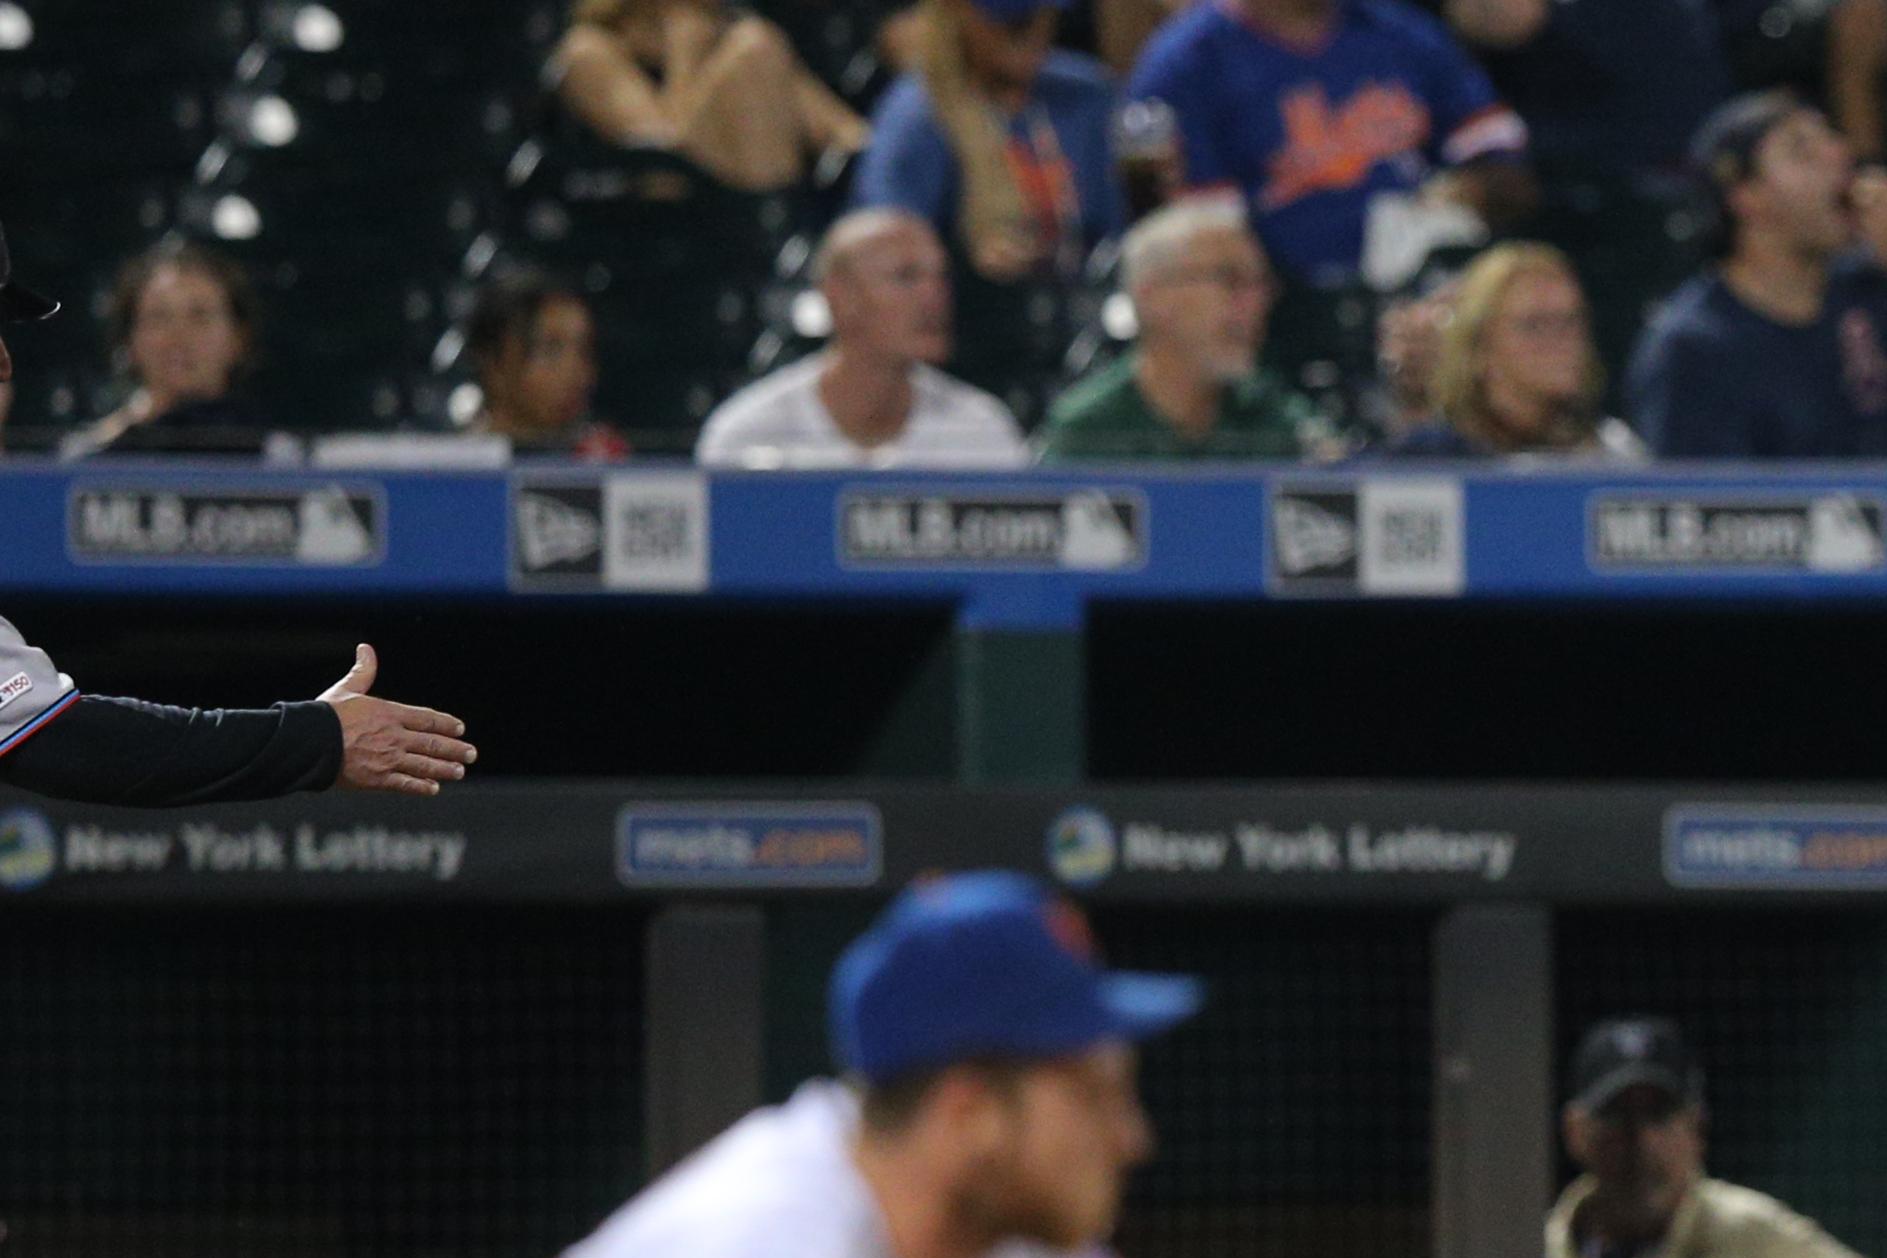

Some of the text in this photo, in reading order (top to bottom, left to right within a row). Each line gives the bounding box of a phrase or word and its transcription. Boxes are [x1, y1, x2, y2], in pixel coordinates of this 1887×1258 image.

[84, 493, 295, 553] MLB.com
[852, 497, 1060, 557] MLB.com
[1602, 503, 1806, 562] MLB.com
[65, 822, 467, 881] New York Lottery
[1123, 822, 1516, 882] New York Lottery
